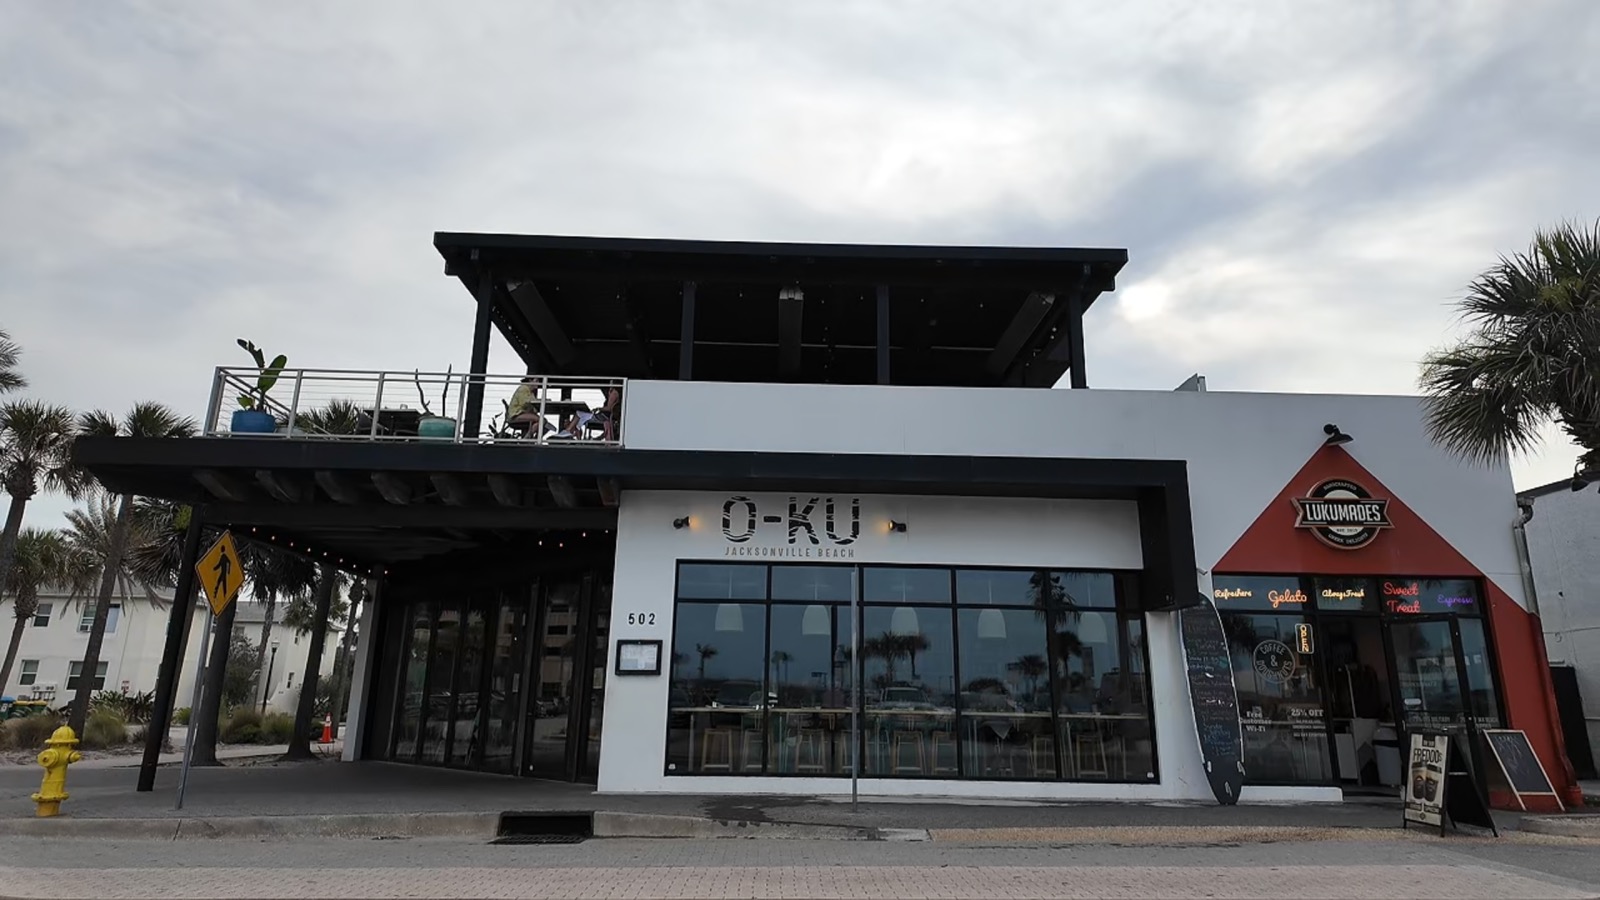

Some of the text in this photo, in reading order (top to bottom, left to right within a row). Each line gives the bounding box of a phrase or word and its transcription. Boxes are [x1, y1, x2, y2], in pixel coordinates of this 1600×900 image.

[1305, 503, 1381, 522] LUKUMADES
[722, 495, 860, 545] O-KU
[724, 546, 855, 558] JACKSONVILLE BEACH
[1214, 588, 1252, 600] Refreshers
[1383, 582, 1419, 596] Sweet
[1267, 588, 1308, 608] Gelato
[1437, 594, 1474, 608] Espresso
[1386, 600, 1421, 613] Treat
[628, 613, 656, 626] 502
[1300, 624, 1310, 652] OPEN
[1260, 643, 1286, 655] COFFEE
[1270, 654, 1278, 667] &
